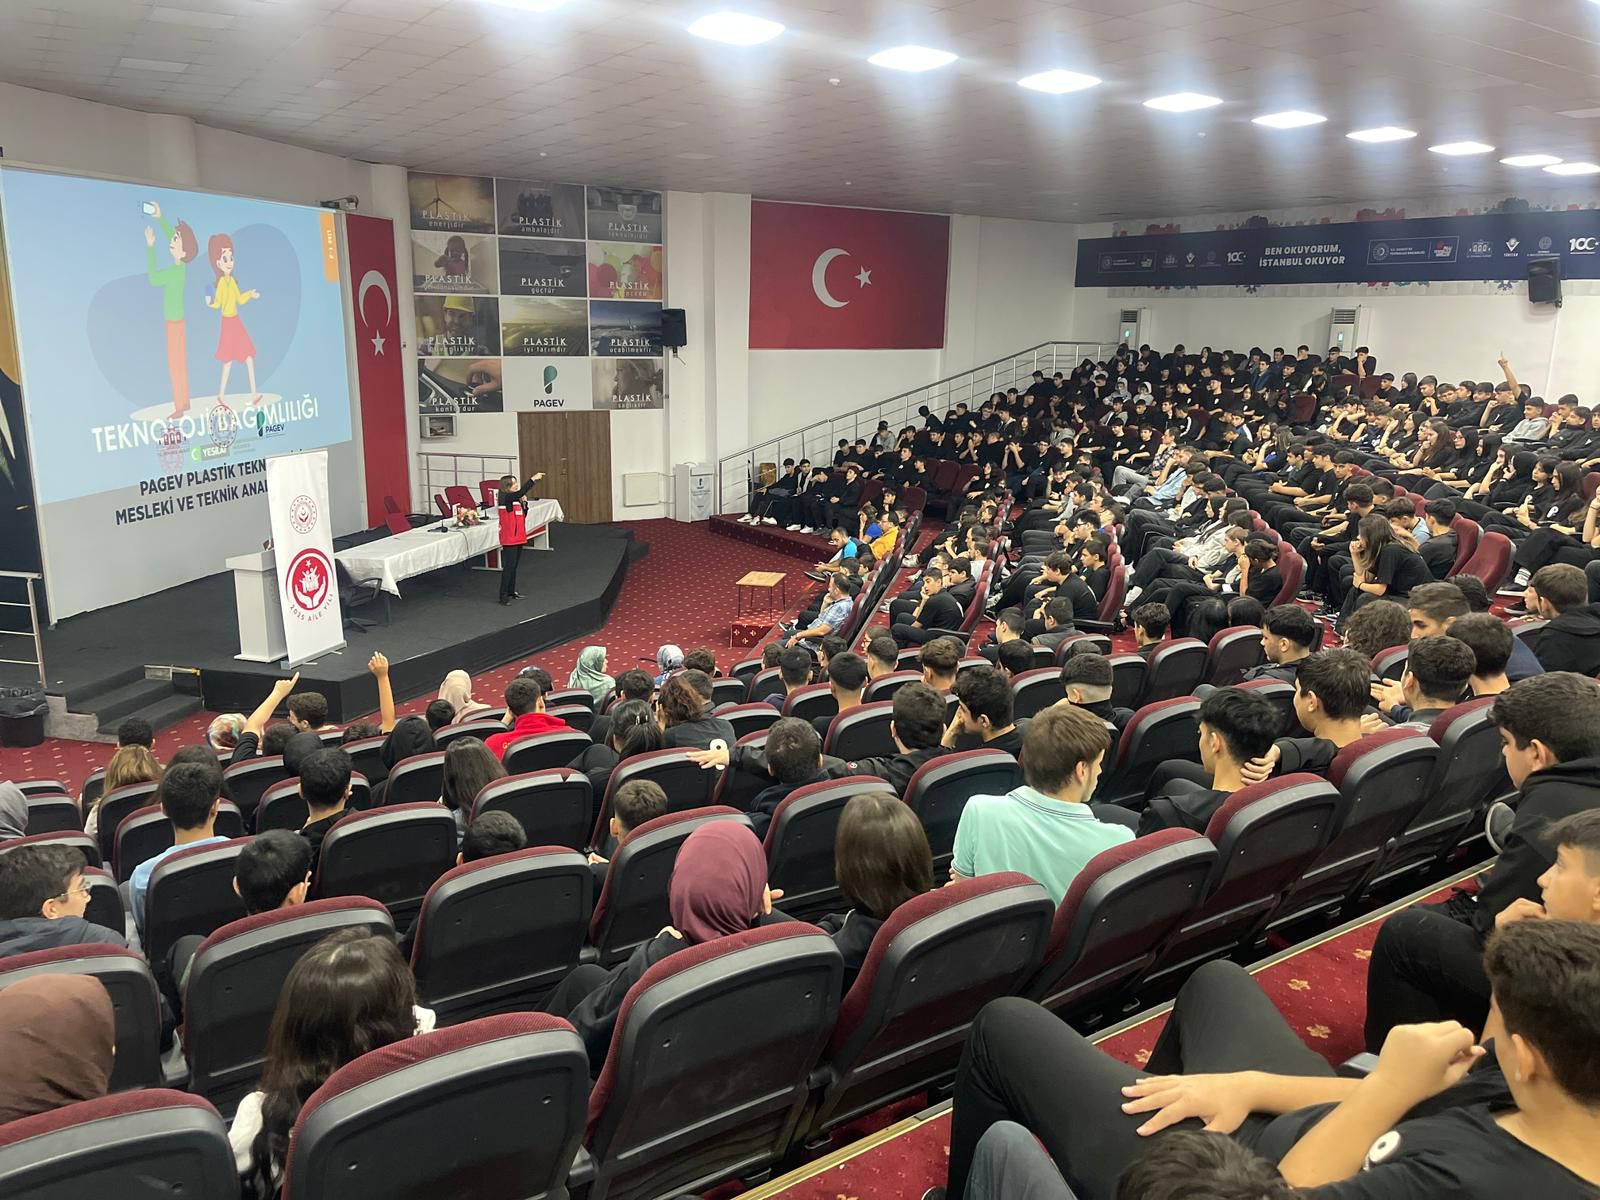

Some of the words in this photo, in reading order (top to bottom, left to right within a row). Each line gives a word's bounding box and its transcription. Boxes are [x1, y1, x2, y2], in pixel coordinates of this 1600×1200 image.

[520, 216, 562, 227] PLASTİK
[1264, 247, 1282, 256] BEN
[1284, 244, 1341, 255] OKUYORUM,
[1259, 256, 1303, 267] İSTANBUL
[1304, 255, 1346, 265] OKUYOR
[521, 277, 565, 287] PLASTİK
[523, 336, 566, 346] PLASTİK
[611, 337, 650, 347] PLASTİK
[533, 399, 565, 408] PAGEV
[92, 408, 212, 453] TEKNOOJİ
[217, 393, 319, 431] BAĞMLILIĞI
[265, 423, 285, 434] PAGEV
[140, 473, 183, 497] PAGEV
[187, 462, 236, 487] PLASTİK
[237, 458, 267, 477] TEKN
[115, 498, 174, 526] MESLEKİ
[176, 494, 195, 512] VE
[198, 487, 239, 509] TEKNİK
